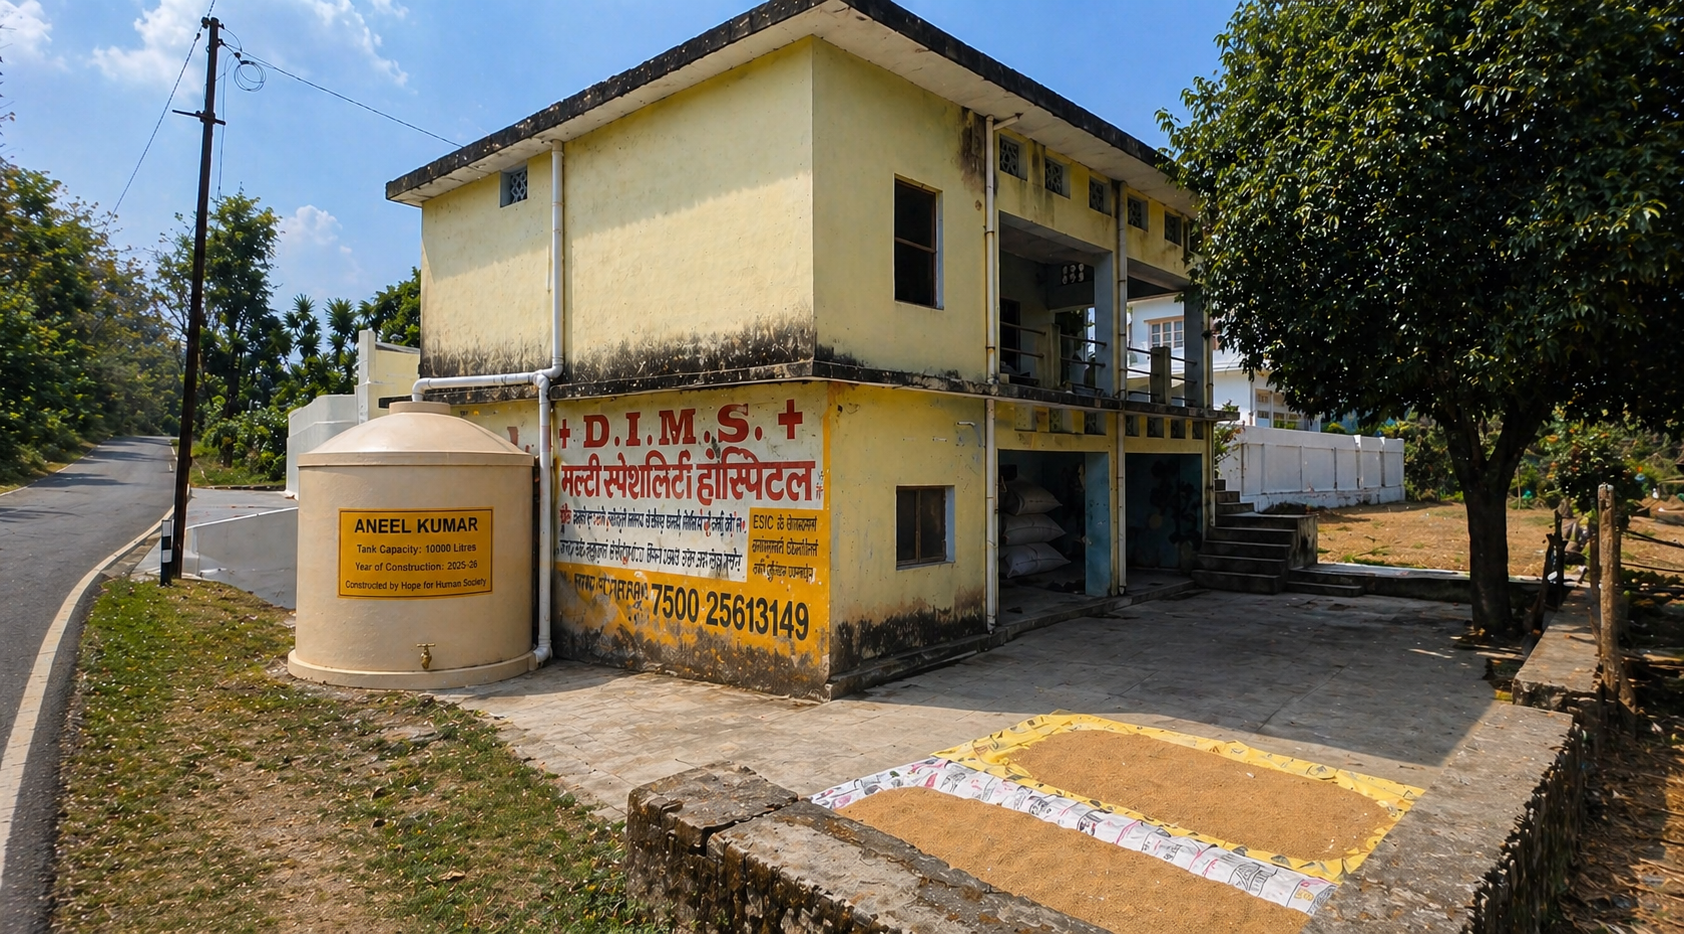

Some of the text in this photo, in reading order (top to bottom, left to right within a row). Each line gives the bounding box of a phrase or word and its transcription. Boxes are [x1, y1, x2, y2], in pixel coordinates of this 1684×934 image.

[561, 453, 602, 497] मल्टी
[354, 517, 478, 534] ANEEL KUMAR
[753, 514, 774, 530] ESIC
[357, 543, 477, 555] Tank Capacity: 10000 Litres
[355, 560, 477, 572] Year of Construction: 2025-26
[389, 581, 399, 592] by
[401, 581, 421, 592] Hope
[423, 580, 434, 589] for
[436, 580, 462, 589] Human
[651, 582, 700, 623] 7500
[705, 591, 809, 641] 25613149
